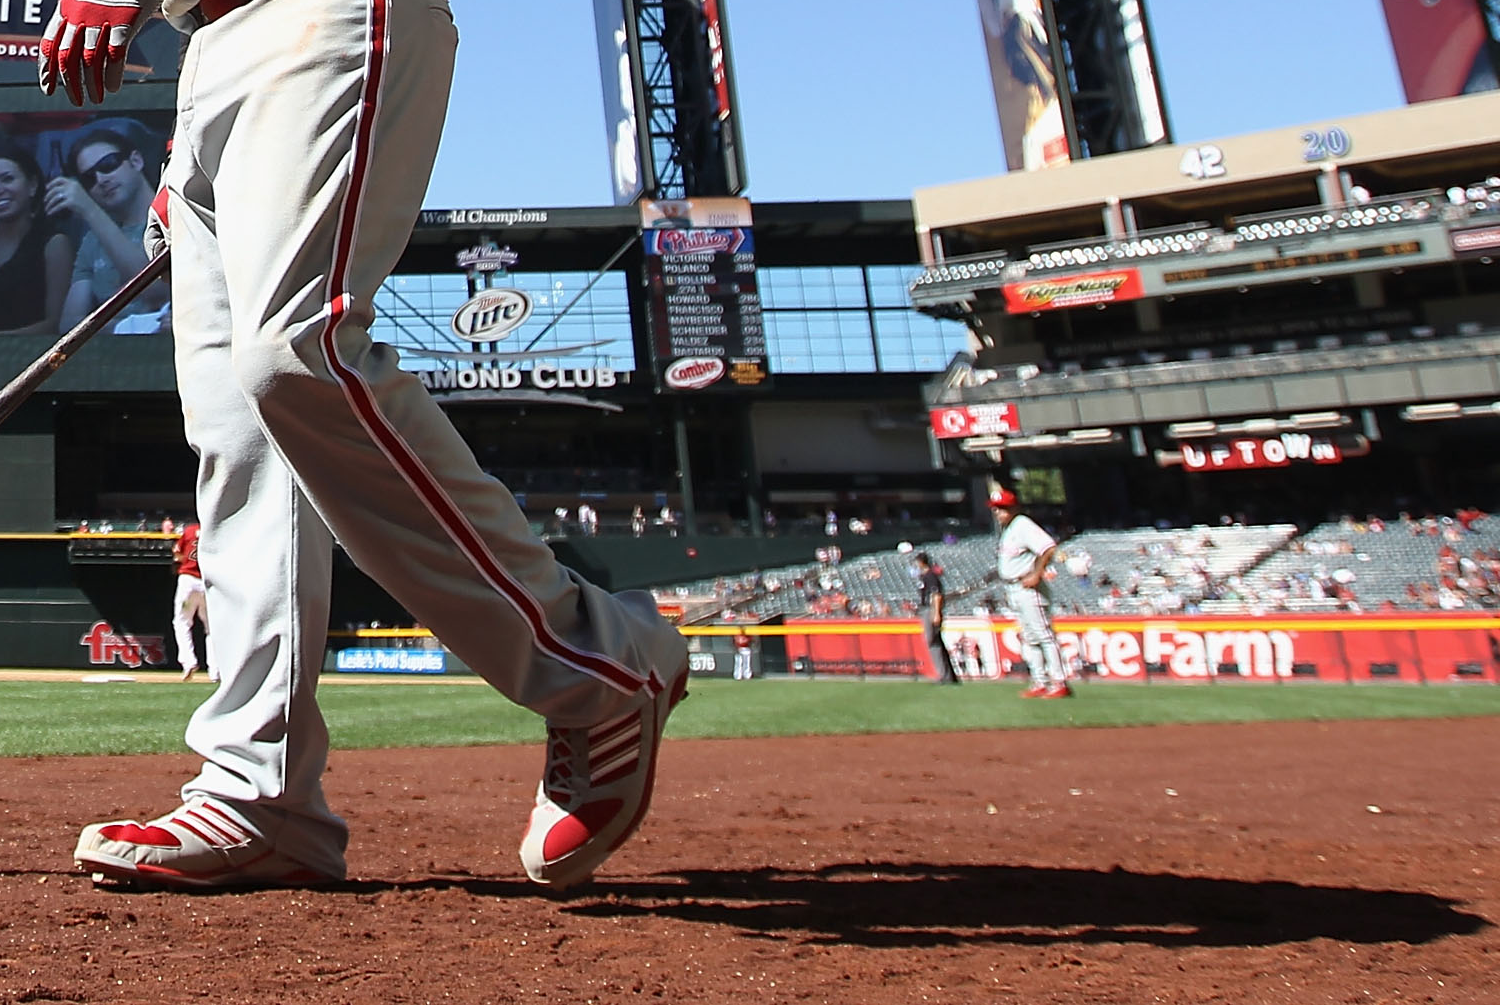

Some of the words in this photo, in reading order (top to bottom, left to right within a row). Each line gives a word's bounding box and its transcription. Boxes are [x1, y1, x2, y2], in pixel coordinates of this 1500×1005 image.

[1300, 125, 1350, 163] 20
[1178, 144, 1228, 180] 42
[421, 209, 466, 225] World
[466, 209, 548, 226] Champions
[666, 230, 730, 254] Phillies
[663, 254, 716, 263] VICTORINO
[664, 264, 710, 274] POLANCO
[677, 275, 717, 285] ROLLINS
[668, 294, 711, 305] HOWARD
[668, 305, 724, 315] FRANCISCO
[670, 315, 722, 325] MAYBERRY
[671, 326, 728, 335] SCHNEIDER
[672, 336, 709, 346] VALDEZ
[419, 368, 522, 389] AMOND
[530, 364, 617, 388] CLUB
[1143, 620, 1296, 679] Farm
[375, 649, 400, 669] Pool
[399, 650, 444, 672] Supplies
